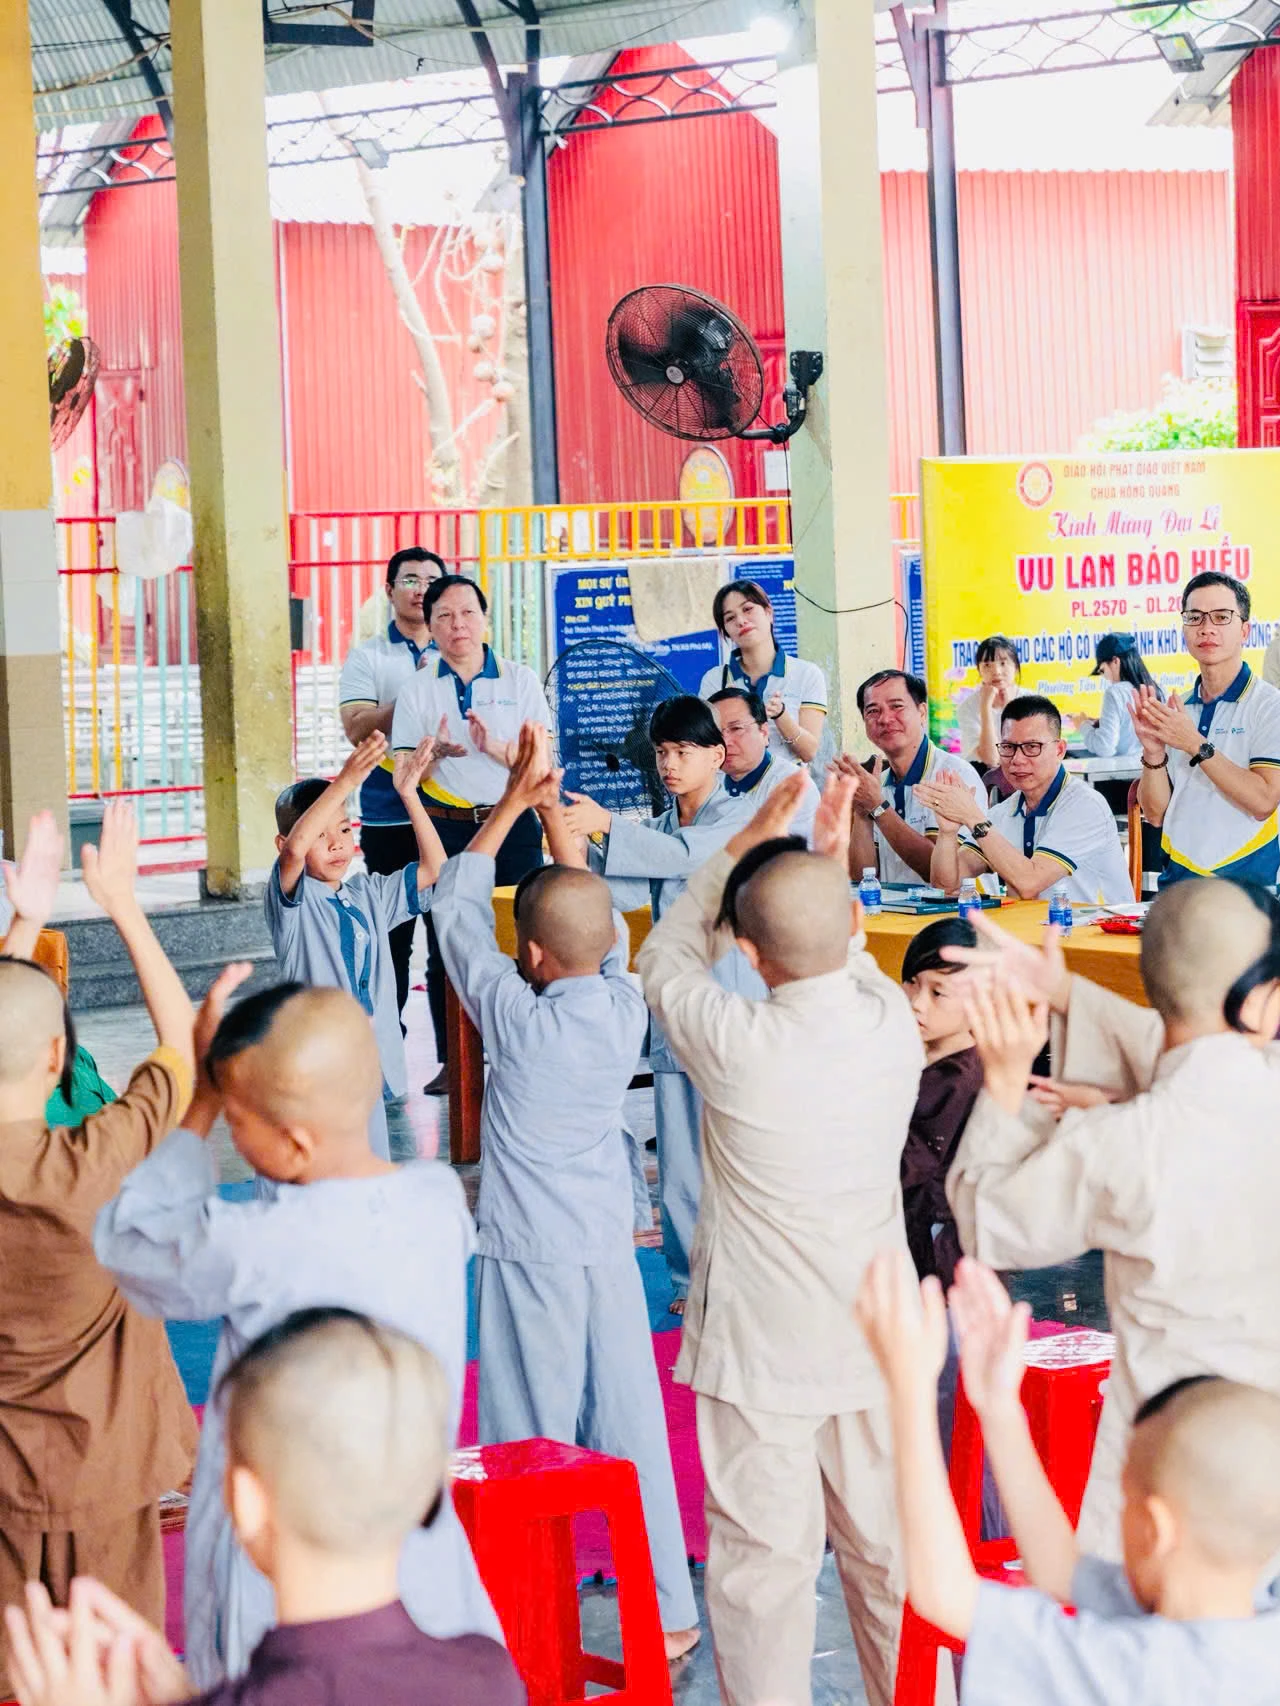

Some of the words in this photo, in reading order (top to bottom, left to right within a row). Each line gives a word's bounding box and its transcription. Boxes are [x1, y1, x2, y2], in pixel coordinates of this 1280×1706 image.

[1184, 460, 1206, 474] NAM
[1149, 483, 1180, 498] QUANG
[1018, 556, 1054, 591] VU
[1066, 553, 1116, 590] LAN
[1127, 545, 1180, 587] BÁO
[1072, 600, 1128, 617] PL.2570
[1146, 596, 1182, 614] DL.20
[1034, 630, 1055, 663] CÁC
[1058, 629, 1073, 666] HỘ
[1076, 629, 1090, 660] CÓ
[1158, 623, 1178, 654] KHÓ
